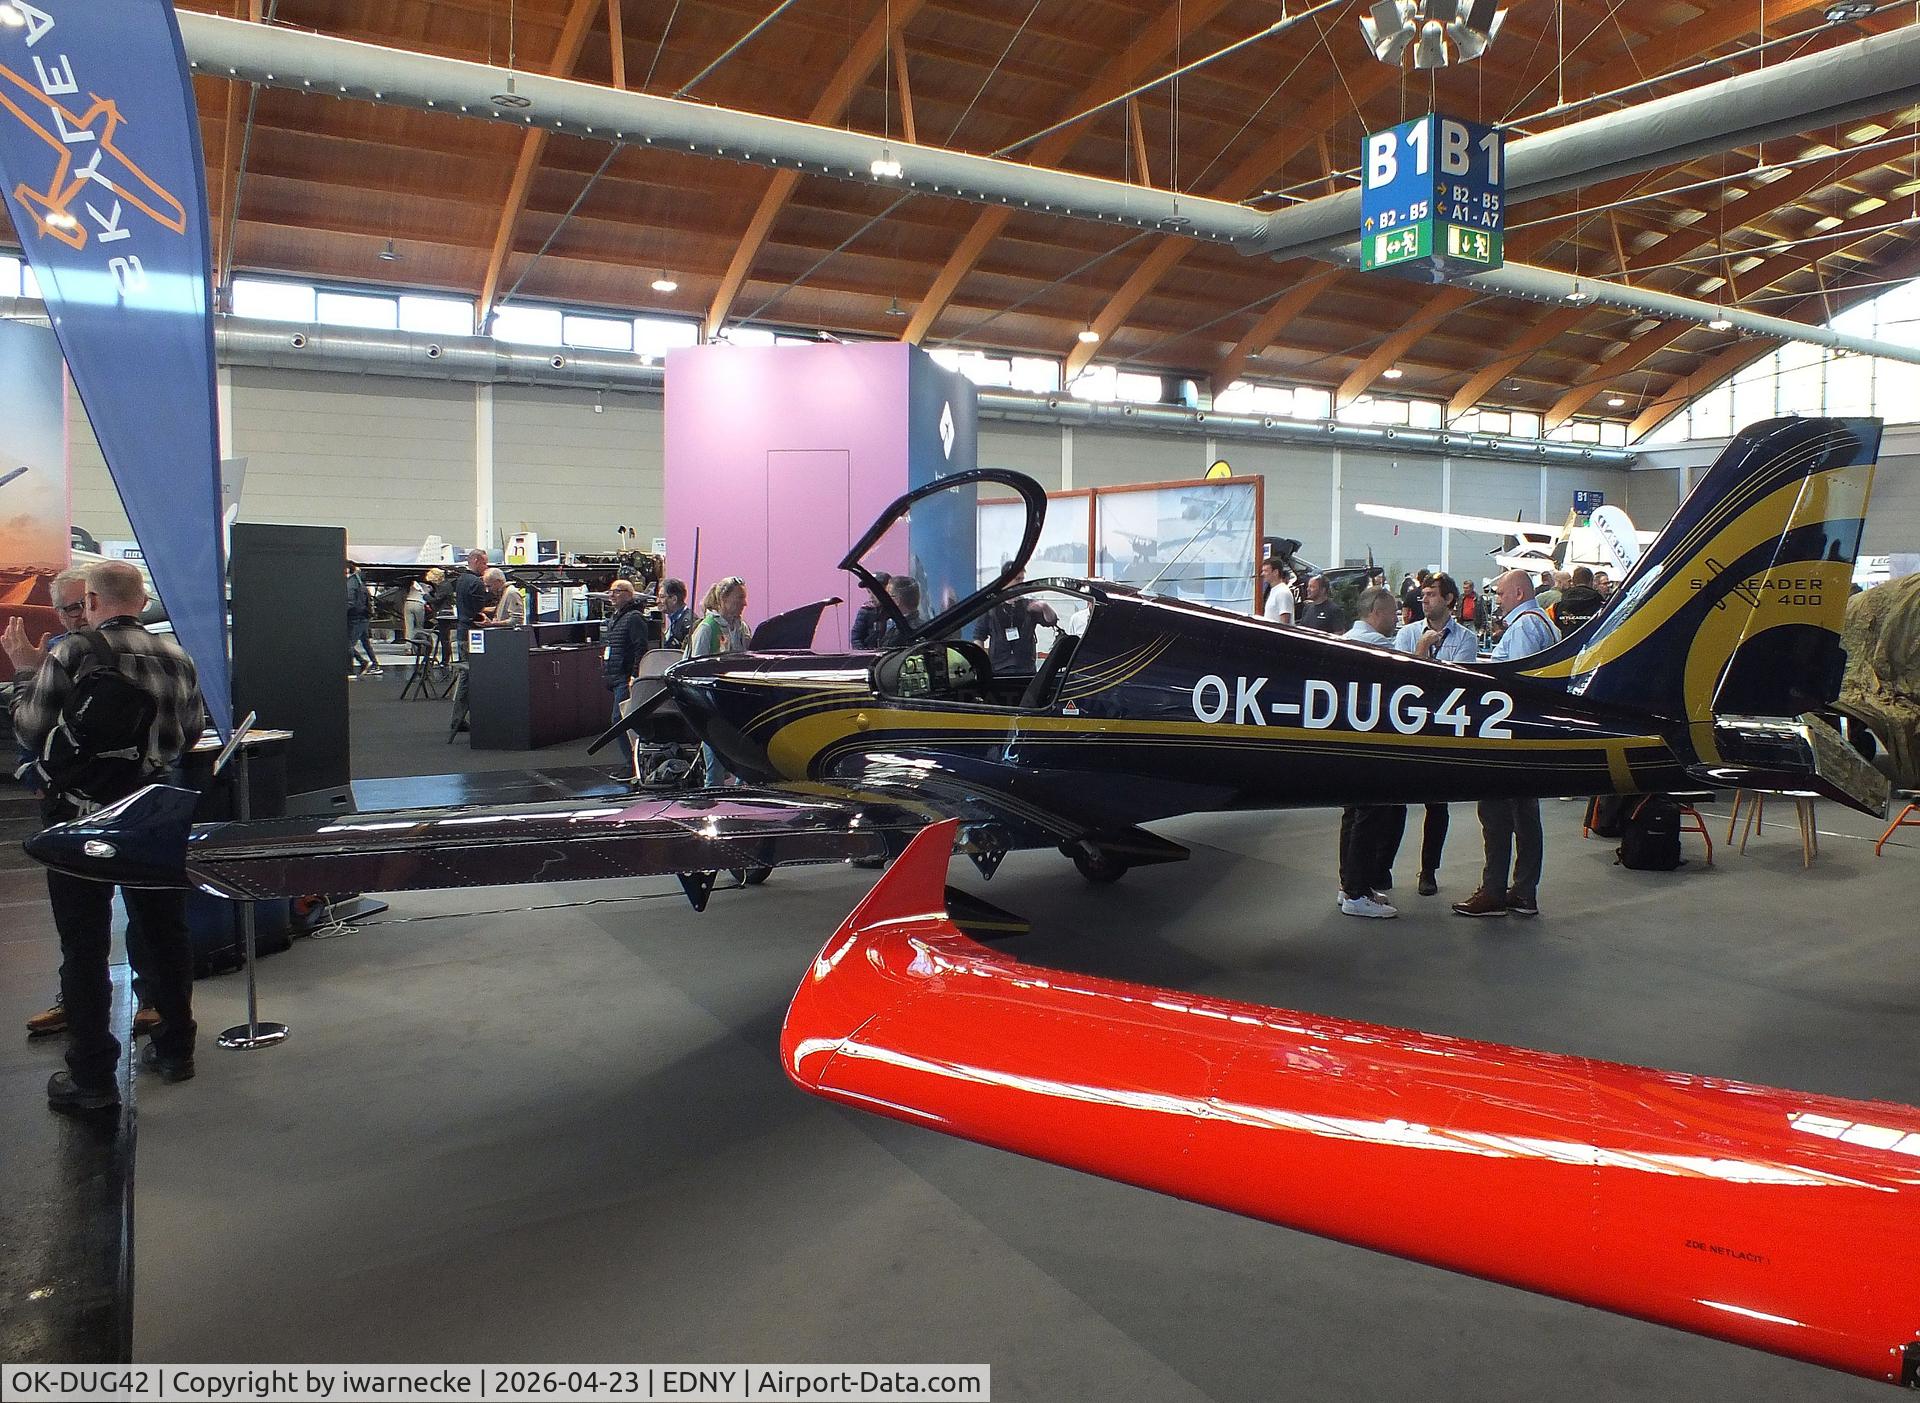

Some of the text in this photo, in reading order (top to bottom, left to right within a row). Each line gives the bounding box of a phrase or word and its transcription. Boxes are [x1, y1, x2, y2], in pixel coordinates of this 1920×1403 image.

[1452, 185, 1469, 204] B2
[1482, 192, 1499, 211] B5
[1379, 210, 1396, 230] B2
[1409, 200, 1428, 221] B5
[1452, 204, 1469, 222] A1
[1481, 211, 1499, 229] A7
[1577, 491, 1588, 502] B1
[1690, 578, 1822, 590] SLEADER
[1778, 594, 1822, 606] 400
[1191, 674, 1514, 740] OK-DUG42
[1684, 1239, 1706, 1251] ZDE
